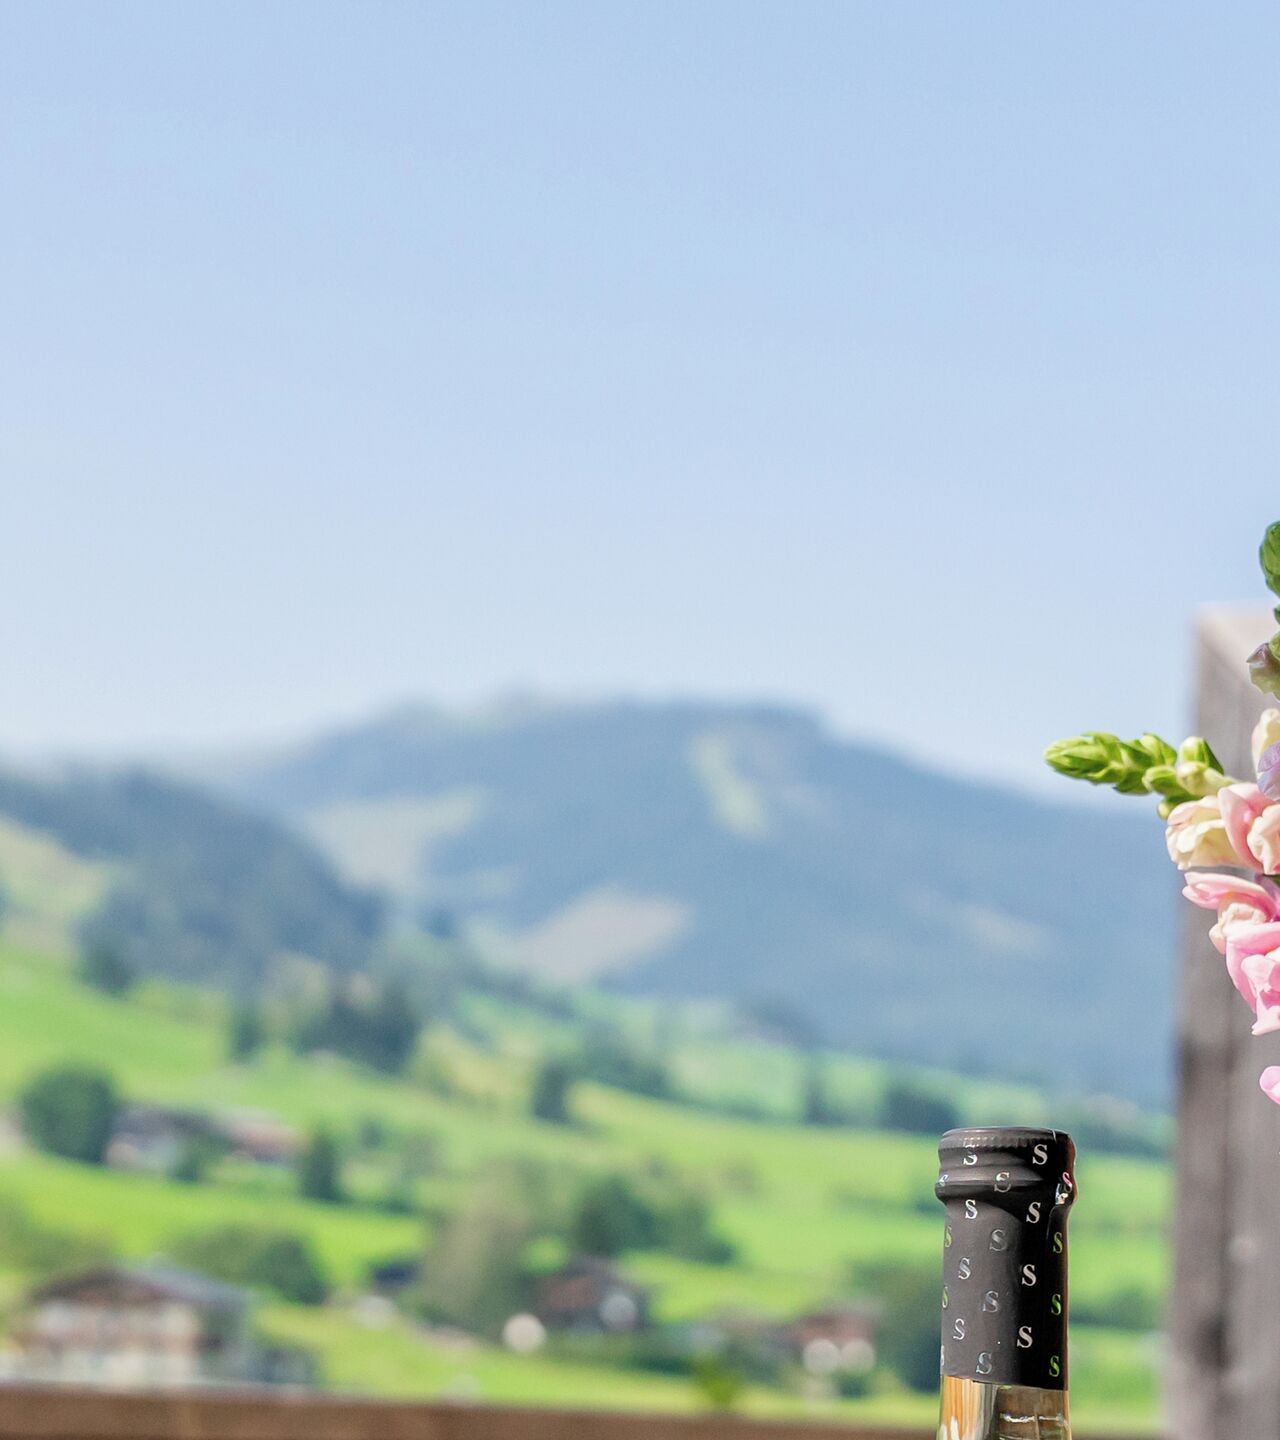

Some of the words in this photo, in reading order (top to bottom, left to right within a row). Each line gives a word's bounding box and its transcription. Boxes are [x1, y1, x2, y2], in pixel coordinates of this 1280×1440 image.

[963, 1145, 978, 1165] S
[1032, 1144, 1048, 1165] S
[994, 1172, 1011, 1193] S
[965, 1199, 978, 1219] S
[1026, 1202, 1041, 1224] S
[989, 1229, 1007, 1251] S
[1053, 1232, 1063, 1254] S
[958, 1257, 971, 1280] S
[1021, 1264, 1037, 1287] S
[982, 1290, 999, 1313] S
[1051, 1293, 1062, 1316] S
[953, 1318, 965, 1340] S
[1016, 1325, 1033, 1348] S
[976, 1352, 992, 1375] S
[1049, 1355, 1060, 1377] S
